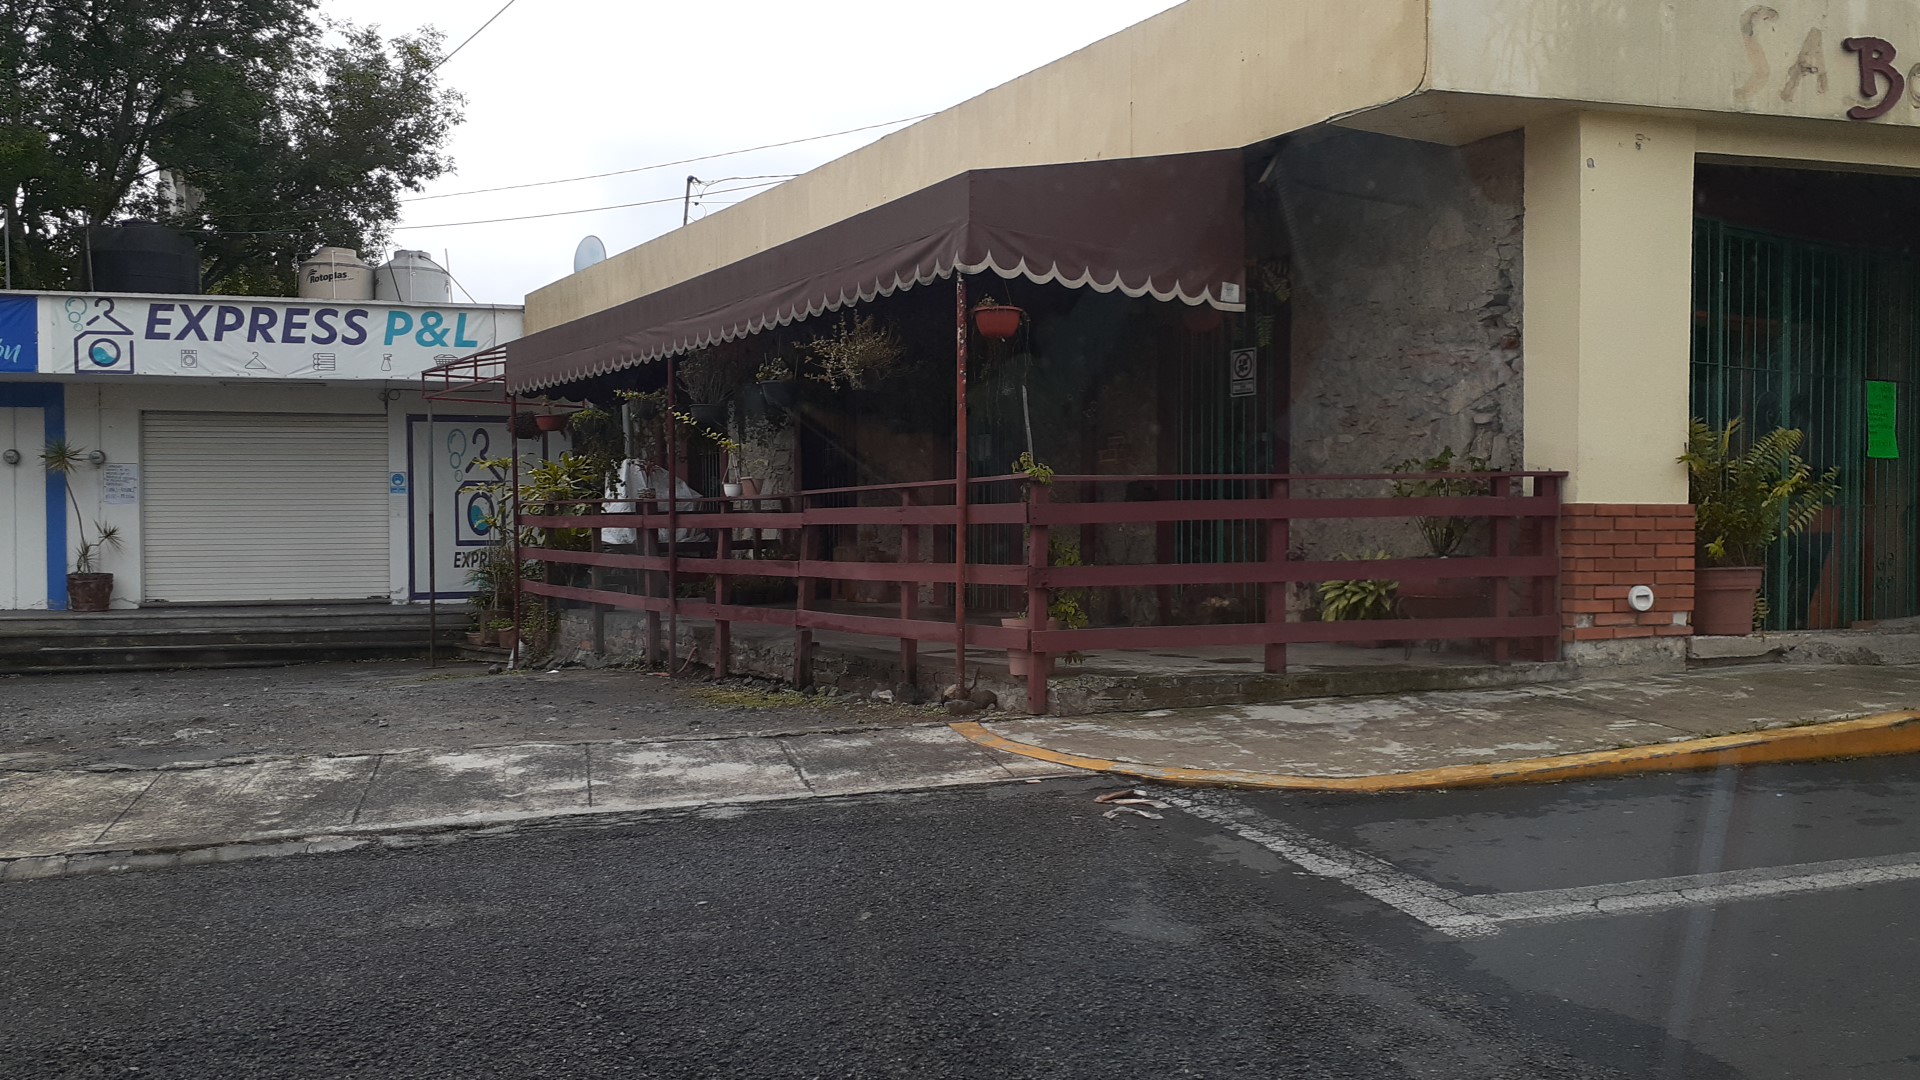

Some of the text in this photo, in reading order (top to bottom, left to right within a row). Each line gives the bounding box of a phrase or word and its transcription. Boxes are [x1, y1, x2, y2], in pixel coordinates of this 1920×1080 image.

[310, 271, 348, 284] Rotoplas
[146, 304, 478, 348] EXPRESS P&L
